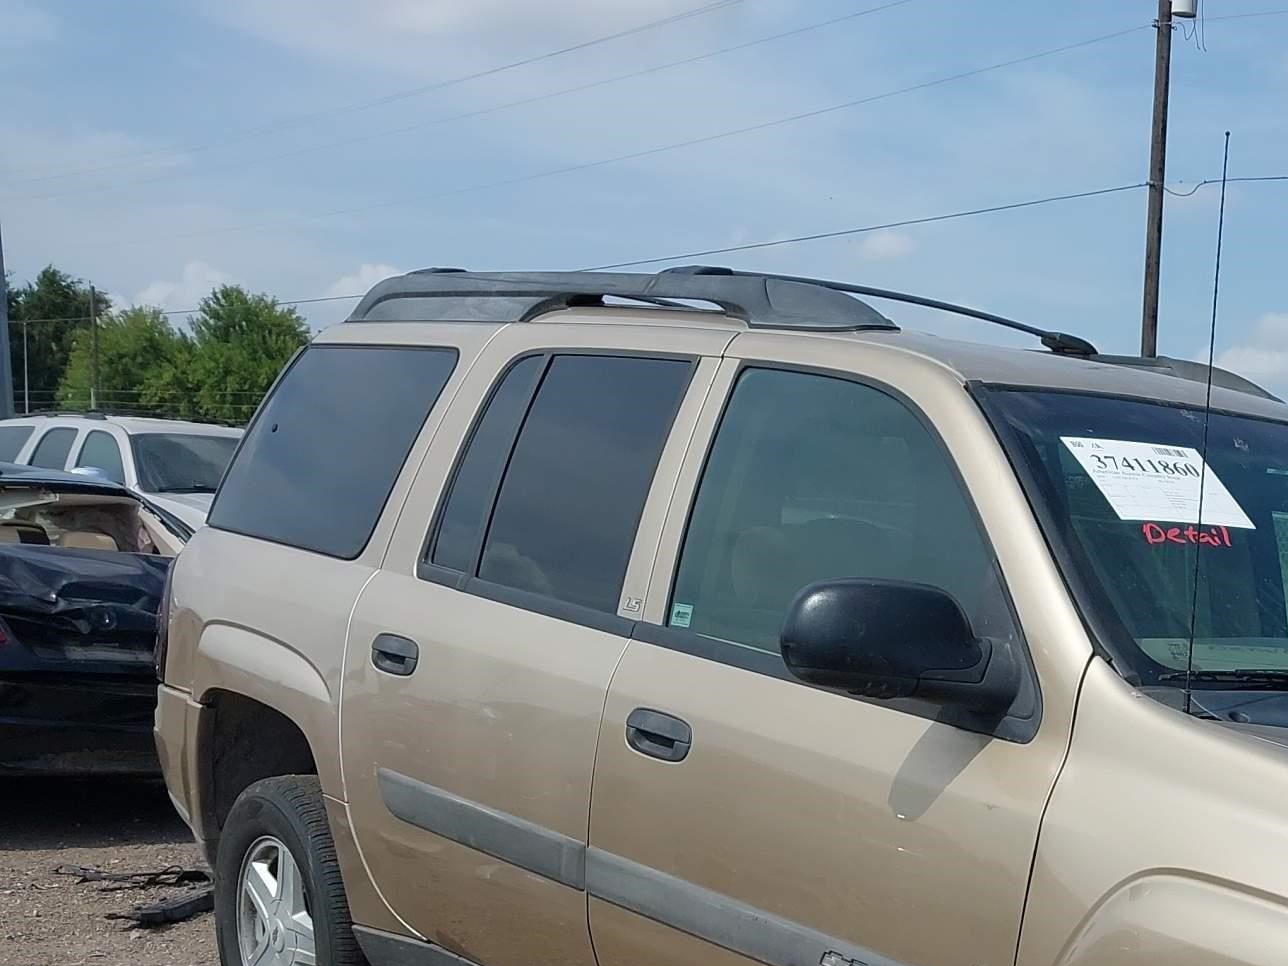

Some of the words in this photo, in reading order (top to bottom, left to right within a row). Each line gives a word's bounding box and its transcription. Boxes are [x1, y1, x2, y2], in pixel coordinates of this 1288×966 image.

[1090, 454, 1200, 478] 37411860
[1142, 521, 1233, 548] Detail
[623, 597, 642, 613] LS
